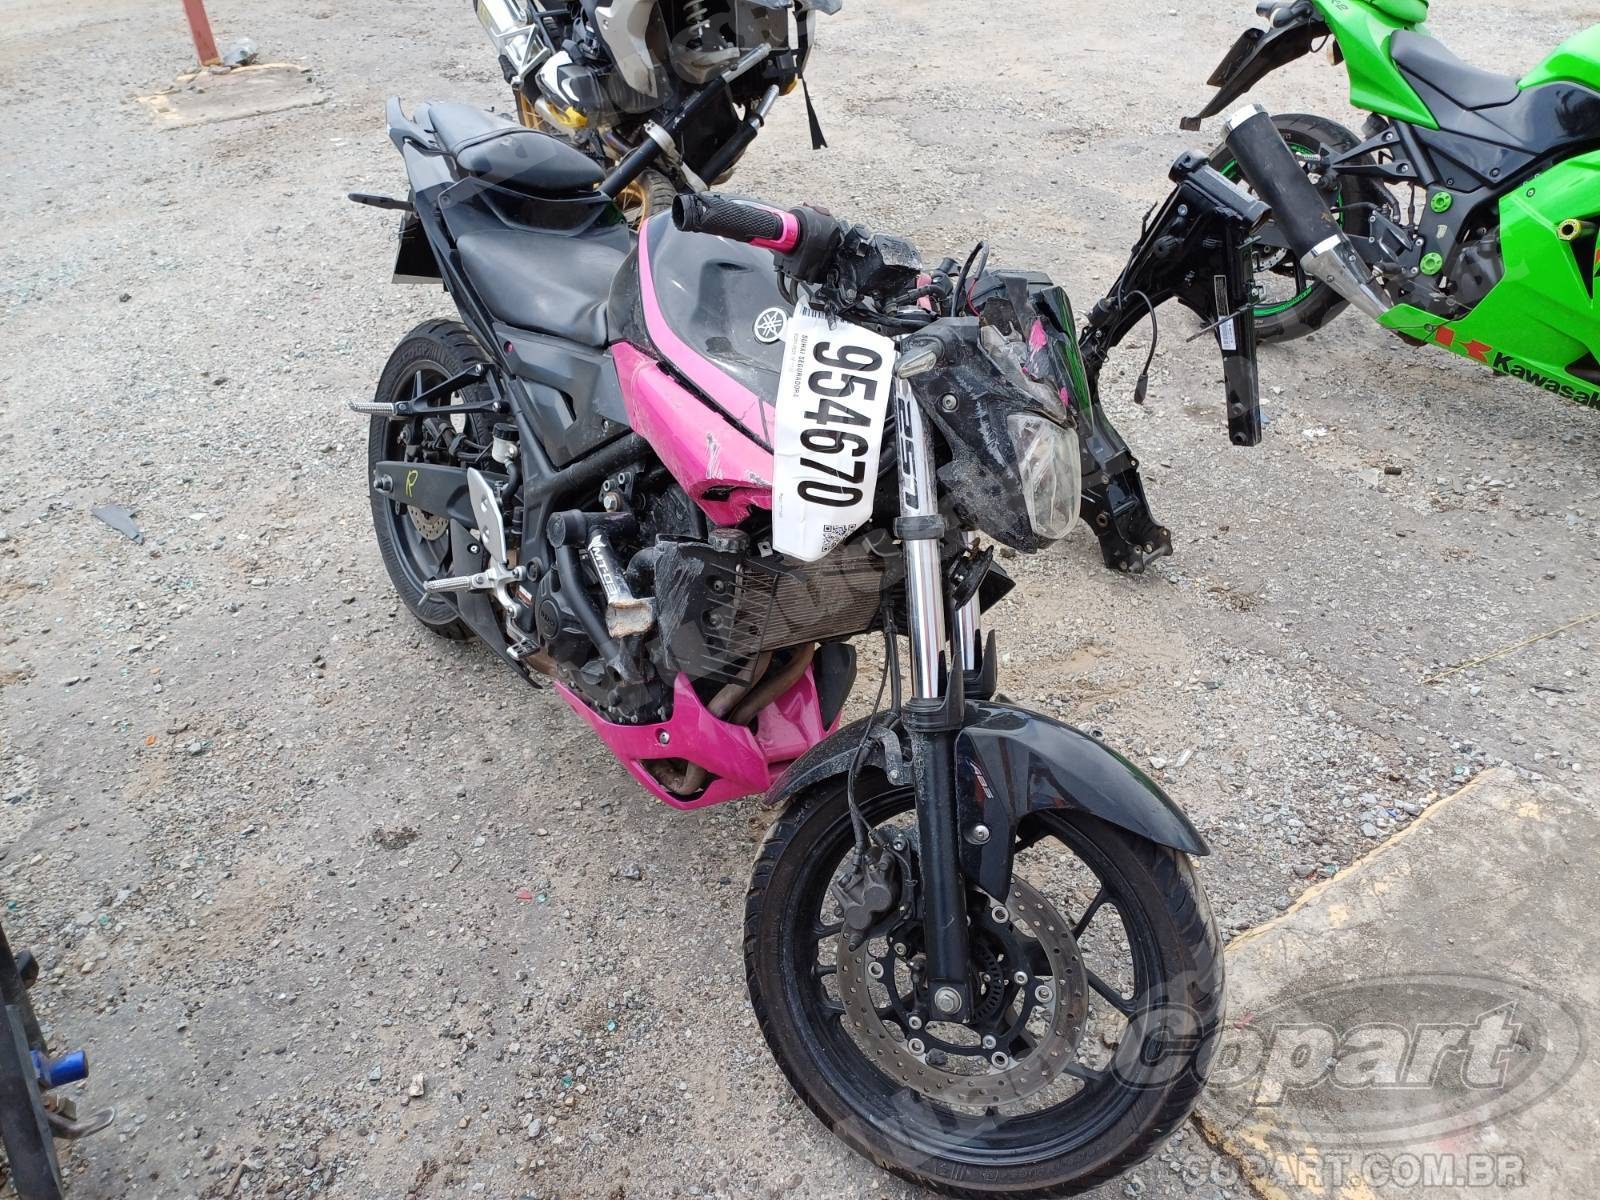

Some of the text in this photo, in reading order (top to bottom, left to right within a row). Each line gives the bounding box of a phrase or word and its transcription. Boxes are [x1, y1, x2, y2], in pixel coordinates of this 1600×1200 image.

[798, 341, 882, 507] 954670
[405, 469, 419, 498] R
[591, 546, 618, 595] MT-03
